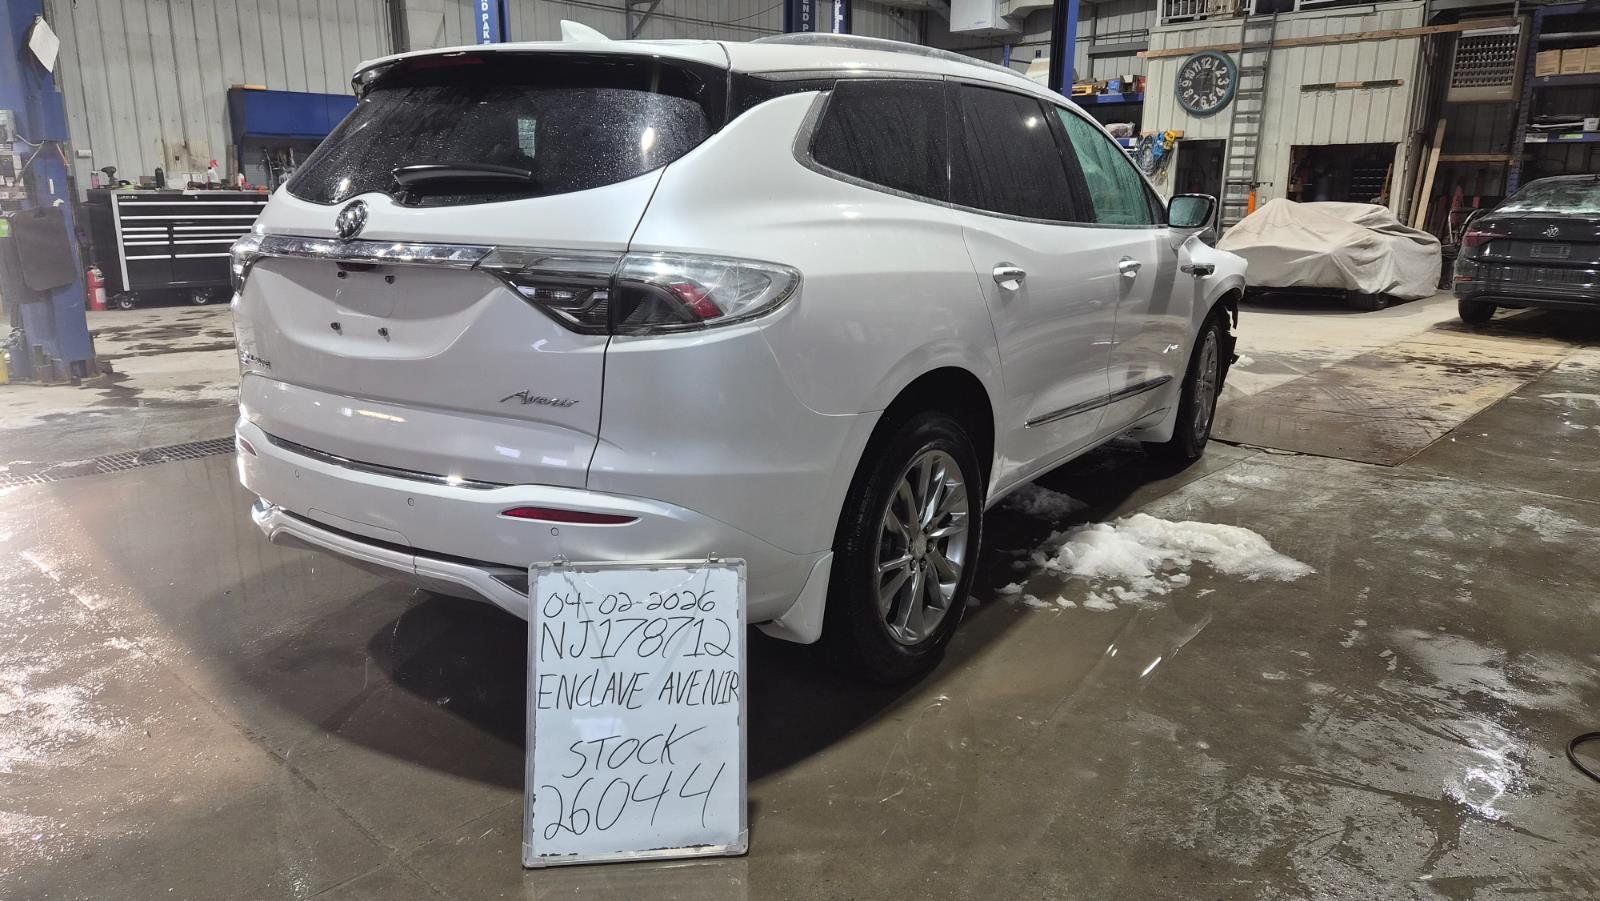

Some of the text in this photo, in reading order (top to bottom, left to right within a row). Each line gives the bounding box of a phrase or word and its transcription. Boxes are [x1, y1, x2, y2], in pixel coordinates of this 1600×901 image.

[1193, 61, 1201, 72] 11
[1200, 57, 1212, 68] 12
[1212, 60, 1220, 70] 1
[1185, 70, 1195, 79] 10
[1216, 67, 1227, 77] 2
[1184, 89, 1193, 97] 8
[1216, 87, 1225, 96] 4
[1191, 94, 1200, 106] 7
[1201, 96, 1207, 107] 6
[1209, 93, 1217, 106] 5
[543, 590, 715, 619] 04-02-2026
[540, 617, 735, 662] NJ178712
[537, 668, 739, 710] ENCLAVE AVENIR
[562, 723, 707, 779] STOCK
[541, 762, 726, 840] 26044
